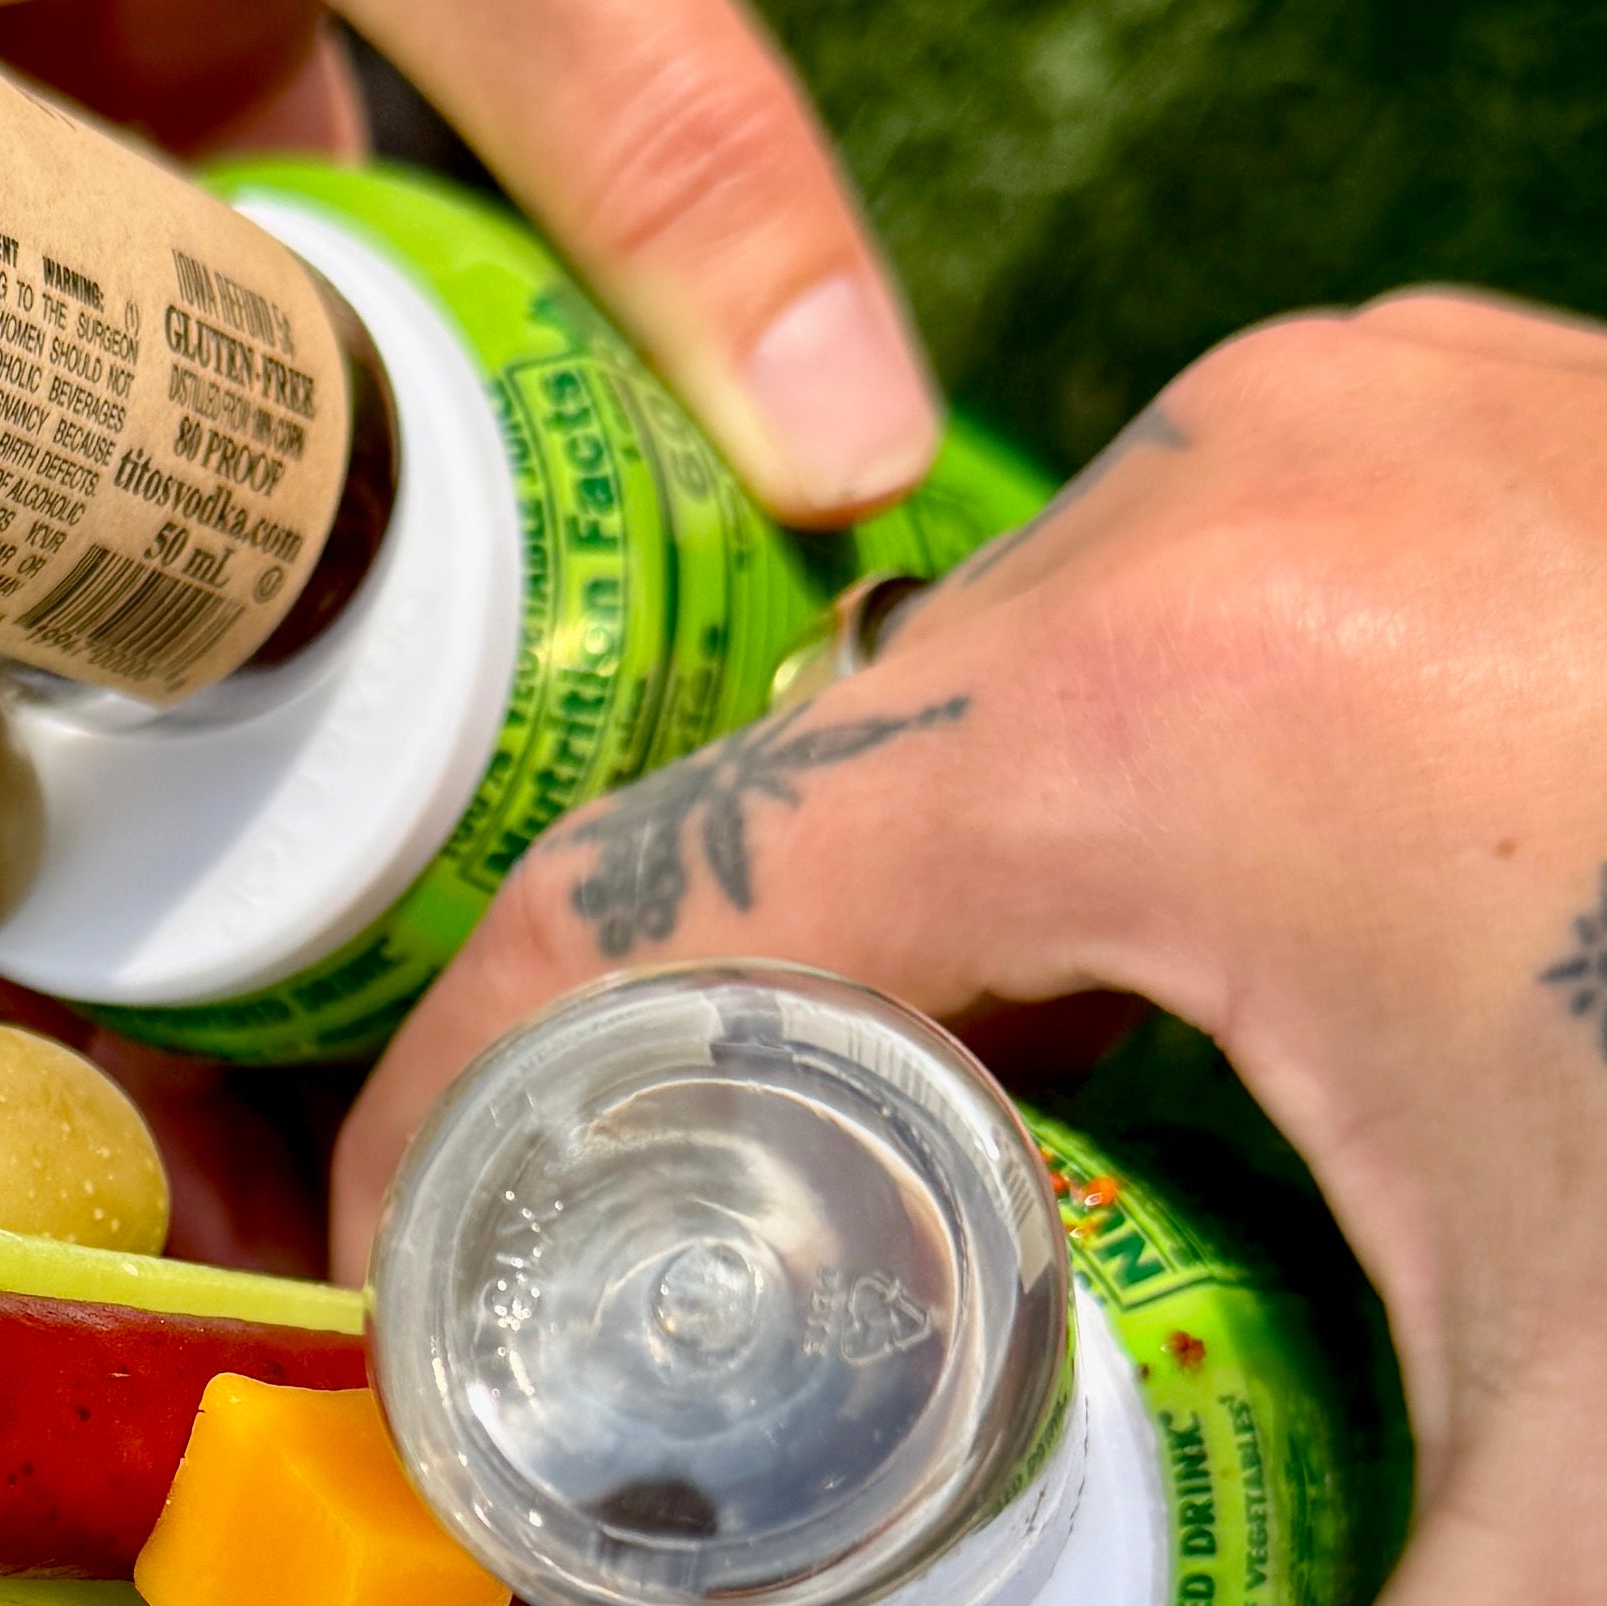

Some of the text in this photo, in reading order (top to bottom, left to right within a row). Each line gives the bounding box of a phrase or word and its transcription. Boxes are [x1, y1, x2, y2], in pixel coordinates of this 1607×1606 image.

[16, 280, 35, 312] TO
[42, 293, 68, 331] THE
[77, 311, 140, 367] SURGEON
[42, 255, 104, 313] WARNING:
[125, 301, 140, 337] (1)
[49, 336, 103, 385] SHOULD
[106, 363, 135, 400] NOT
[164, 303, 316, 422] GLUTEN-FREE
[49, 376, 127, 434] BEVERAGES
[36, 451, 100, 499] DEFECTS.
[53, 418, 117, 468] BECAUSE
[173, 414, 285, 498] 80 PROOF
[546, 371, 618, 552] Facts
[5, 477, 86, 527] ALCOHOLIC
[113, 447, 304, 565] titosvodka.com
[17, 555, 47, 579] OR
[24, 520, 69, 554] YOUR
[143, 520, 237, 589] 50 mL
